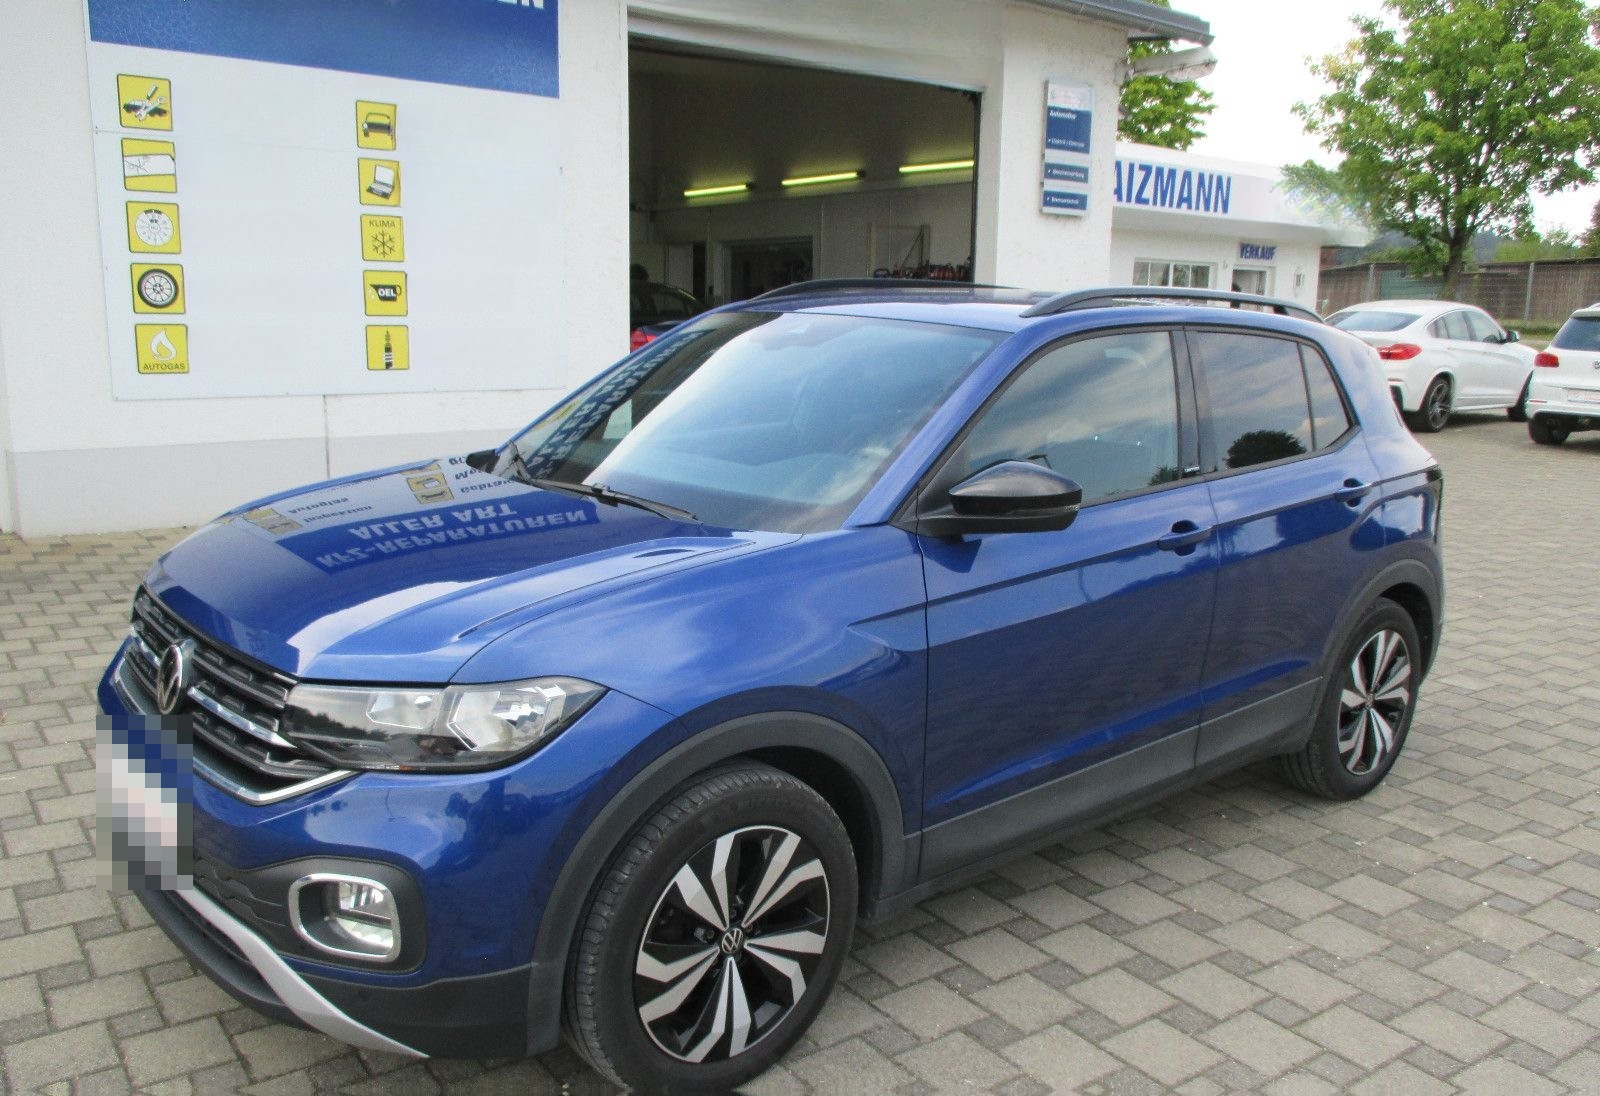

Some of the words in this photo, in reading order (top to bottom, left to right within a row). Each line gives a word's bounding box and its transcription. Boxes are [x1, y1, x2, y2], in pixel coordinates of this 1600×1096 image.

[369, 219, 396, 228] KLIMA
[1239, 242, 1277, 261] VERKAUF
[378, 287, 397, 298] OEL
[143, 362, 186, 371] AUTOGAS
